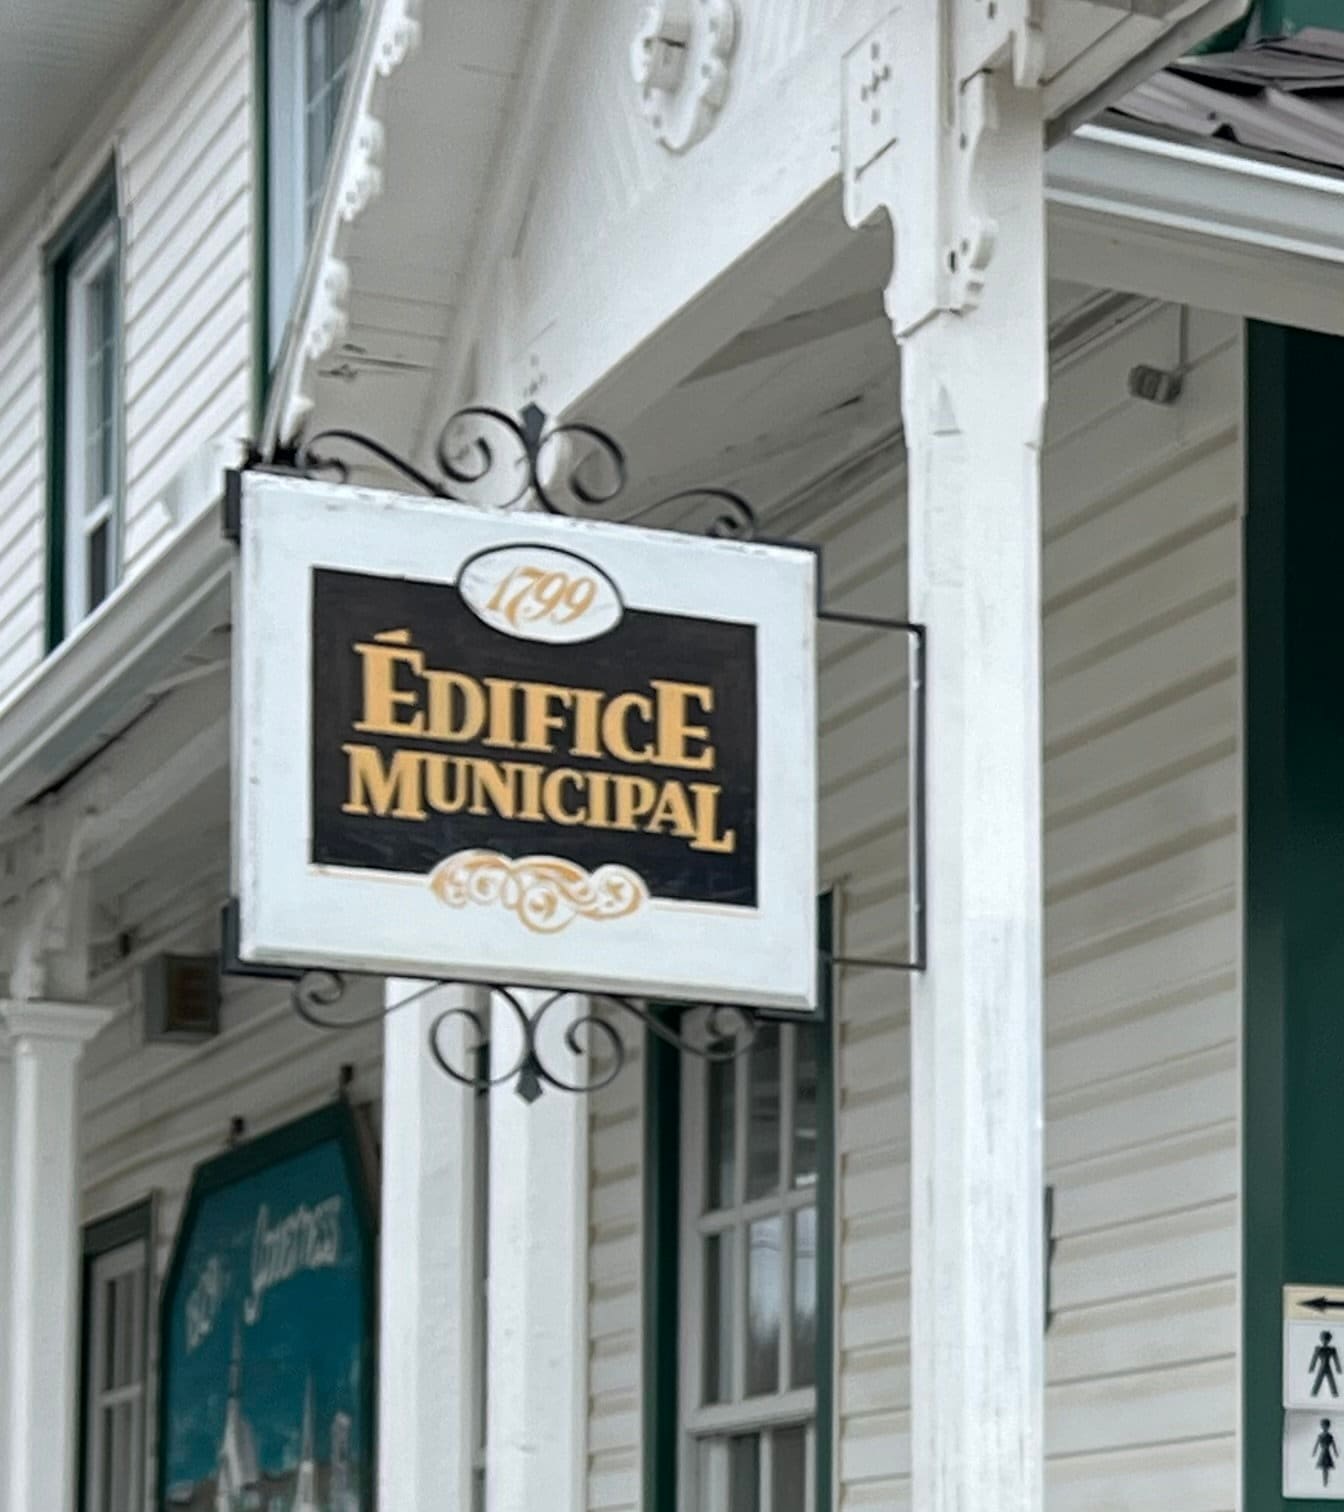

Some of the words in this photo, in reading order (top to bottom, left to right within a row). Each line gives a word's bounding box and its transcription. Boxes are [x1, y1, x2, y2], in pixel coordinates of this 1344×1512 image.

[487, 564, 597, 625] 1799
[353, 628, 716, 770] ÉDIFICE
[341, 744, 736, 854] MUNICIPAL
